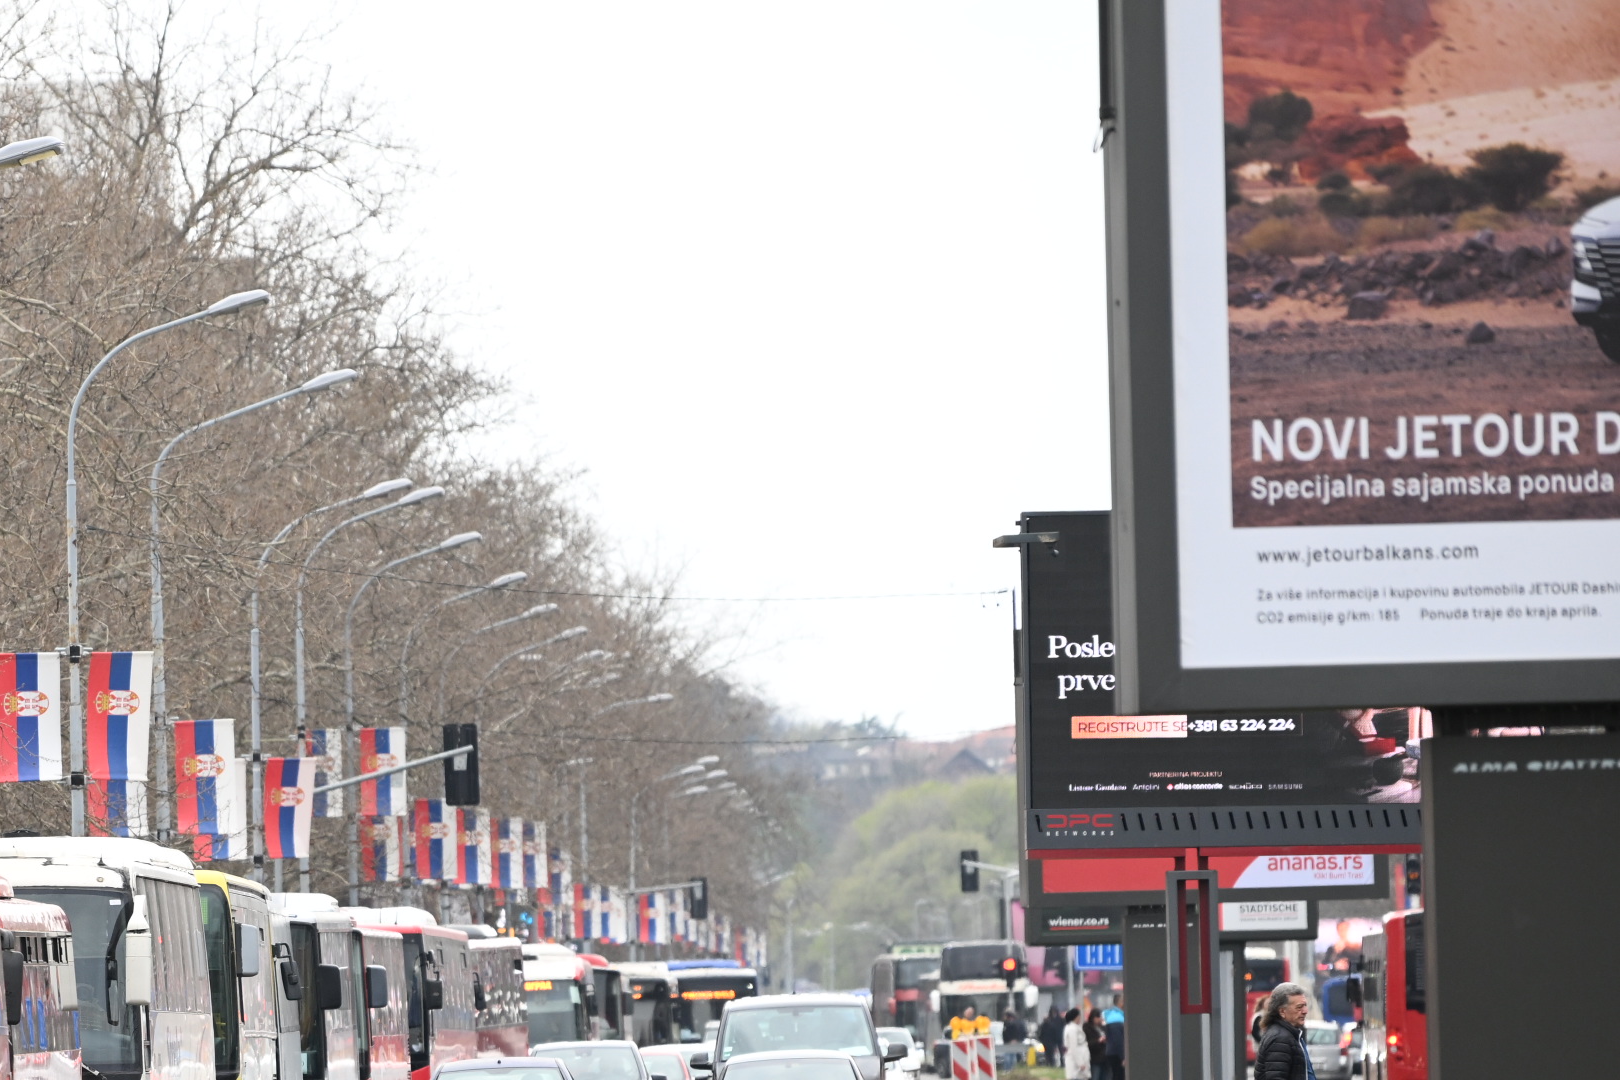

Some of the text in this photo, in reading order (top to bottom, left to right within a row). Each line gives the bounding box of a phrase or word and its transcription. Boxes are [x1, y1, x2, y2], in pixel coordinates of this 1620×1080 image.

[1251, 417, 1370, 462] NOVI
[1385, 411, 1580, 459] JETOUR
[1250, 467, 1614, 505] Specijalna sajamska ponuda
[1257, 543, 1479, 567] www.jetourbalkans.com
[1257, 588, 1273, 601] Za
[1276, 586, 1302, 601] više
[1306, 586, 1379, 603] informacija
[1390, 585, 1449, 602] kupovinu
[1453, 582, 1526, 598] automobila
[1529, 582, 1579, 596] JETOUR
[1257, 610, 1284, 624] CO2
[1288, 608, 1334, 626] emisije
[1379, 608, 1400, 622] 185
[1420, 607, 1469, 621] Ponuda
[1472, 605, 1502, 622] traje
[1507, 605, 1522, 619] do
[1525, 604, 1558, 621] kraja
[1058, 673, 1115, 699] prve
[1078, 721, 1187, 733] REGISTRUJTE SE
[1188, 718, 1296, 732] +381 63 224 224
[1453, 761, 1518, 773] ALMA
[1267, 855, 1364, 871] ananas.rs
[1048, 916, 1110, 927] wiener.co.rs
